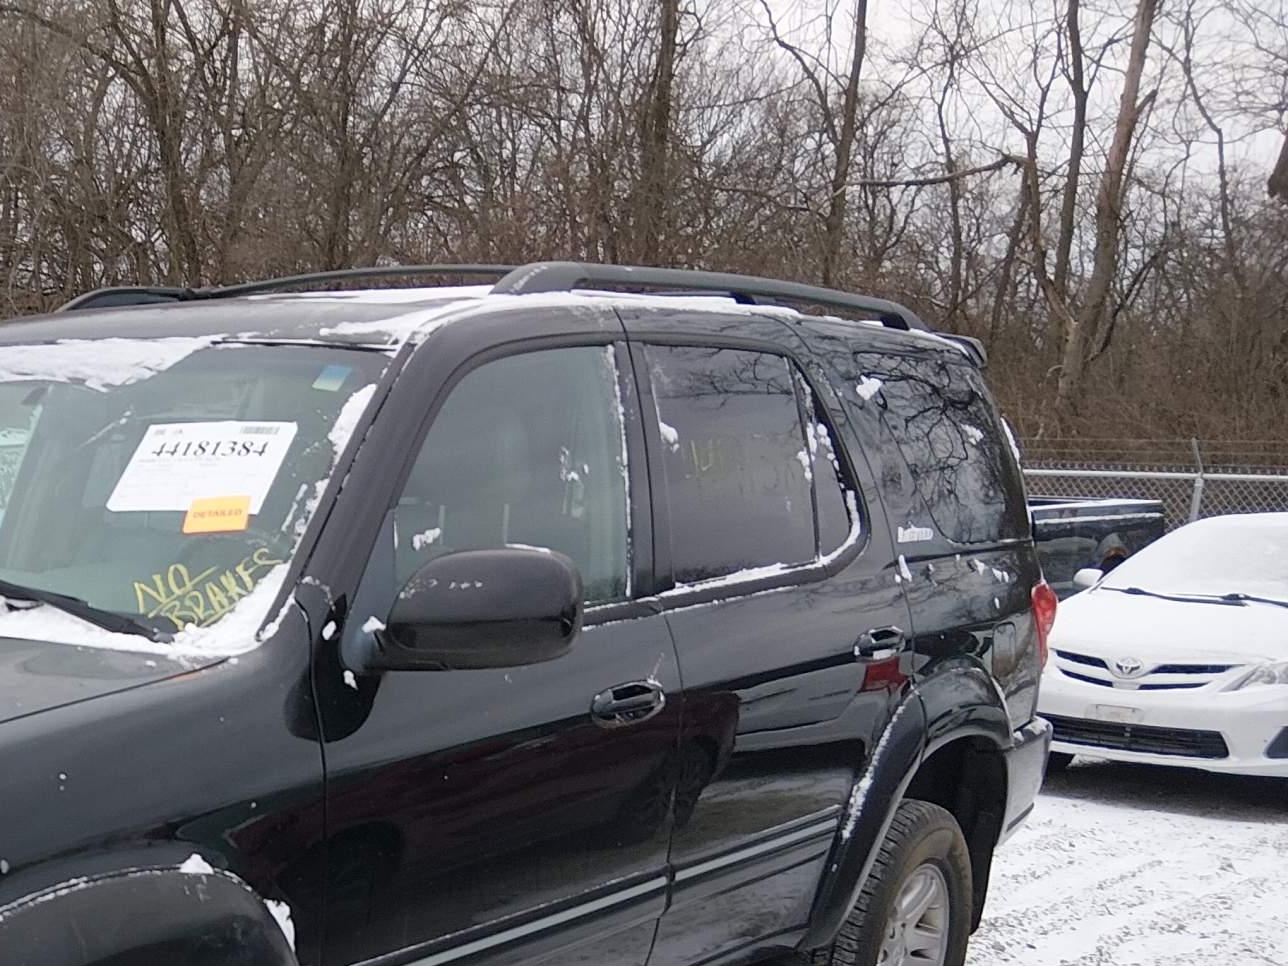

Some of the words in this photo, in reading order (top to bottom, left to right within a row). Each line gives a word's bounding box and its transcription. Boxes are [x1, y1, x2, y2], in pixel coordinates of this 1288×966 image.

[151, 440, 269, 458] 44181384
[192, 507, 244, 520] DETAILED
[133, 563, 191, 615] NO
